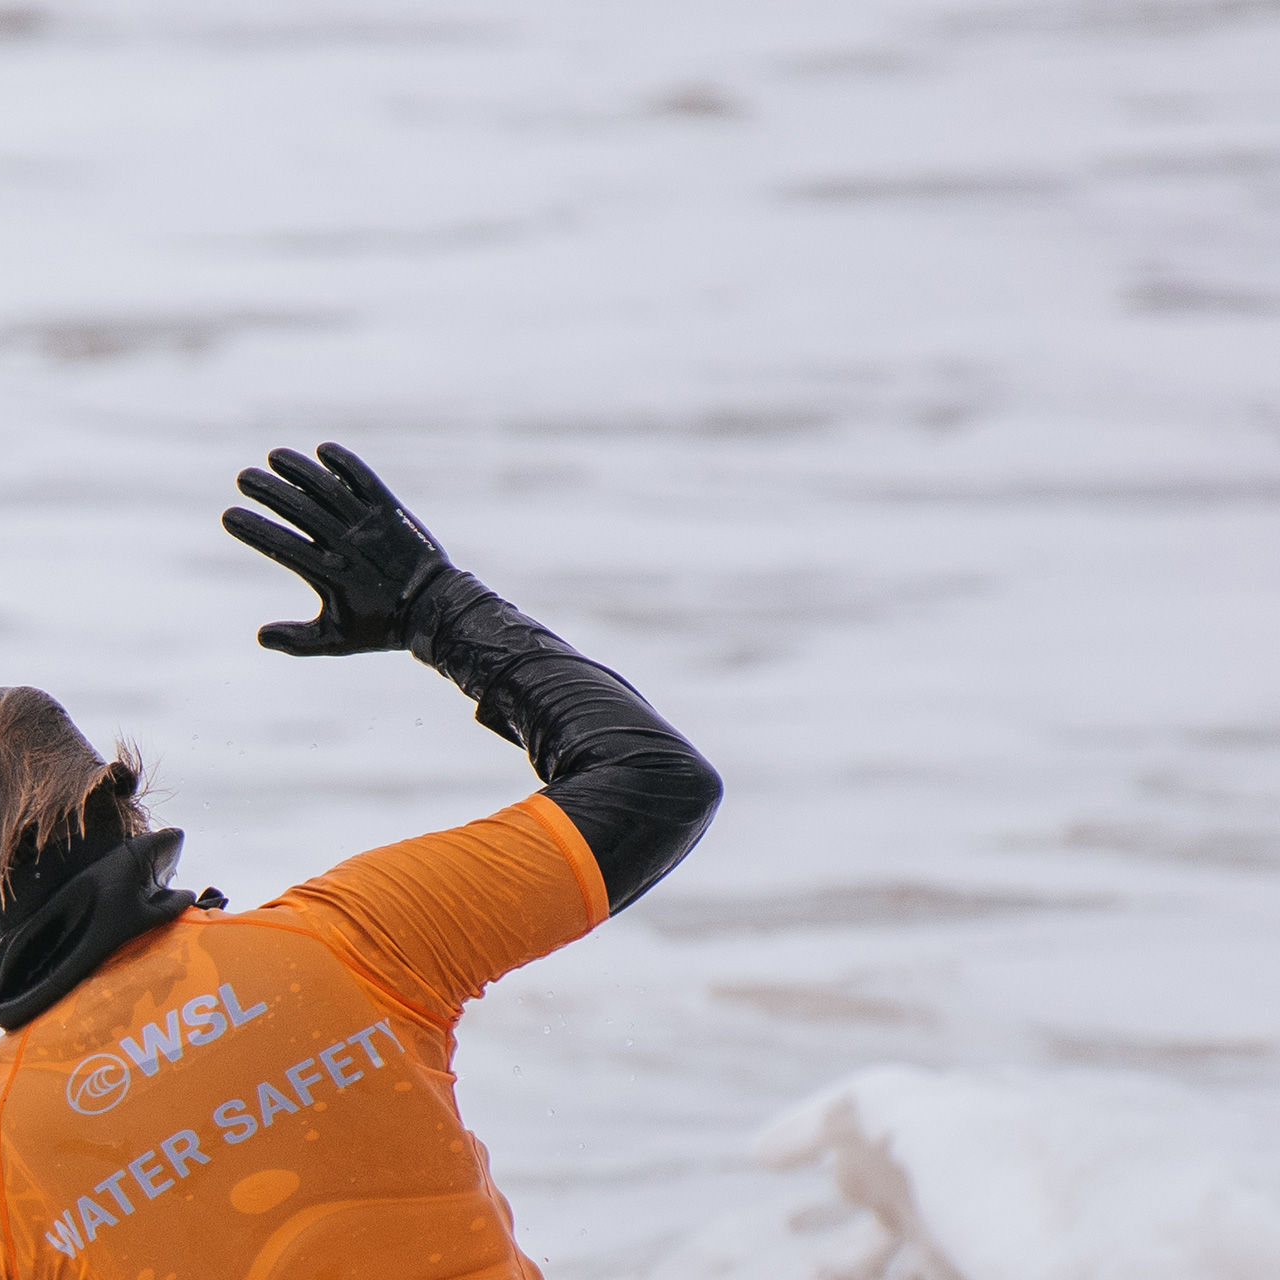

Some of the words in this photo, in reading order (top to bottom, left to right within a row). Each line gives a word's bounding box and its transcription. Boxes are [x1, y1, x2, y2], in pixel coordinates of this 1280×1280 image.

[120, 981, 269, 1078] WSL
[45, 1124, 212, 1260] WATER
[212, 1016, 408, 1147] SAFETY
